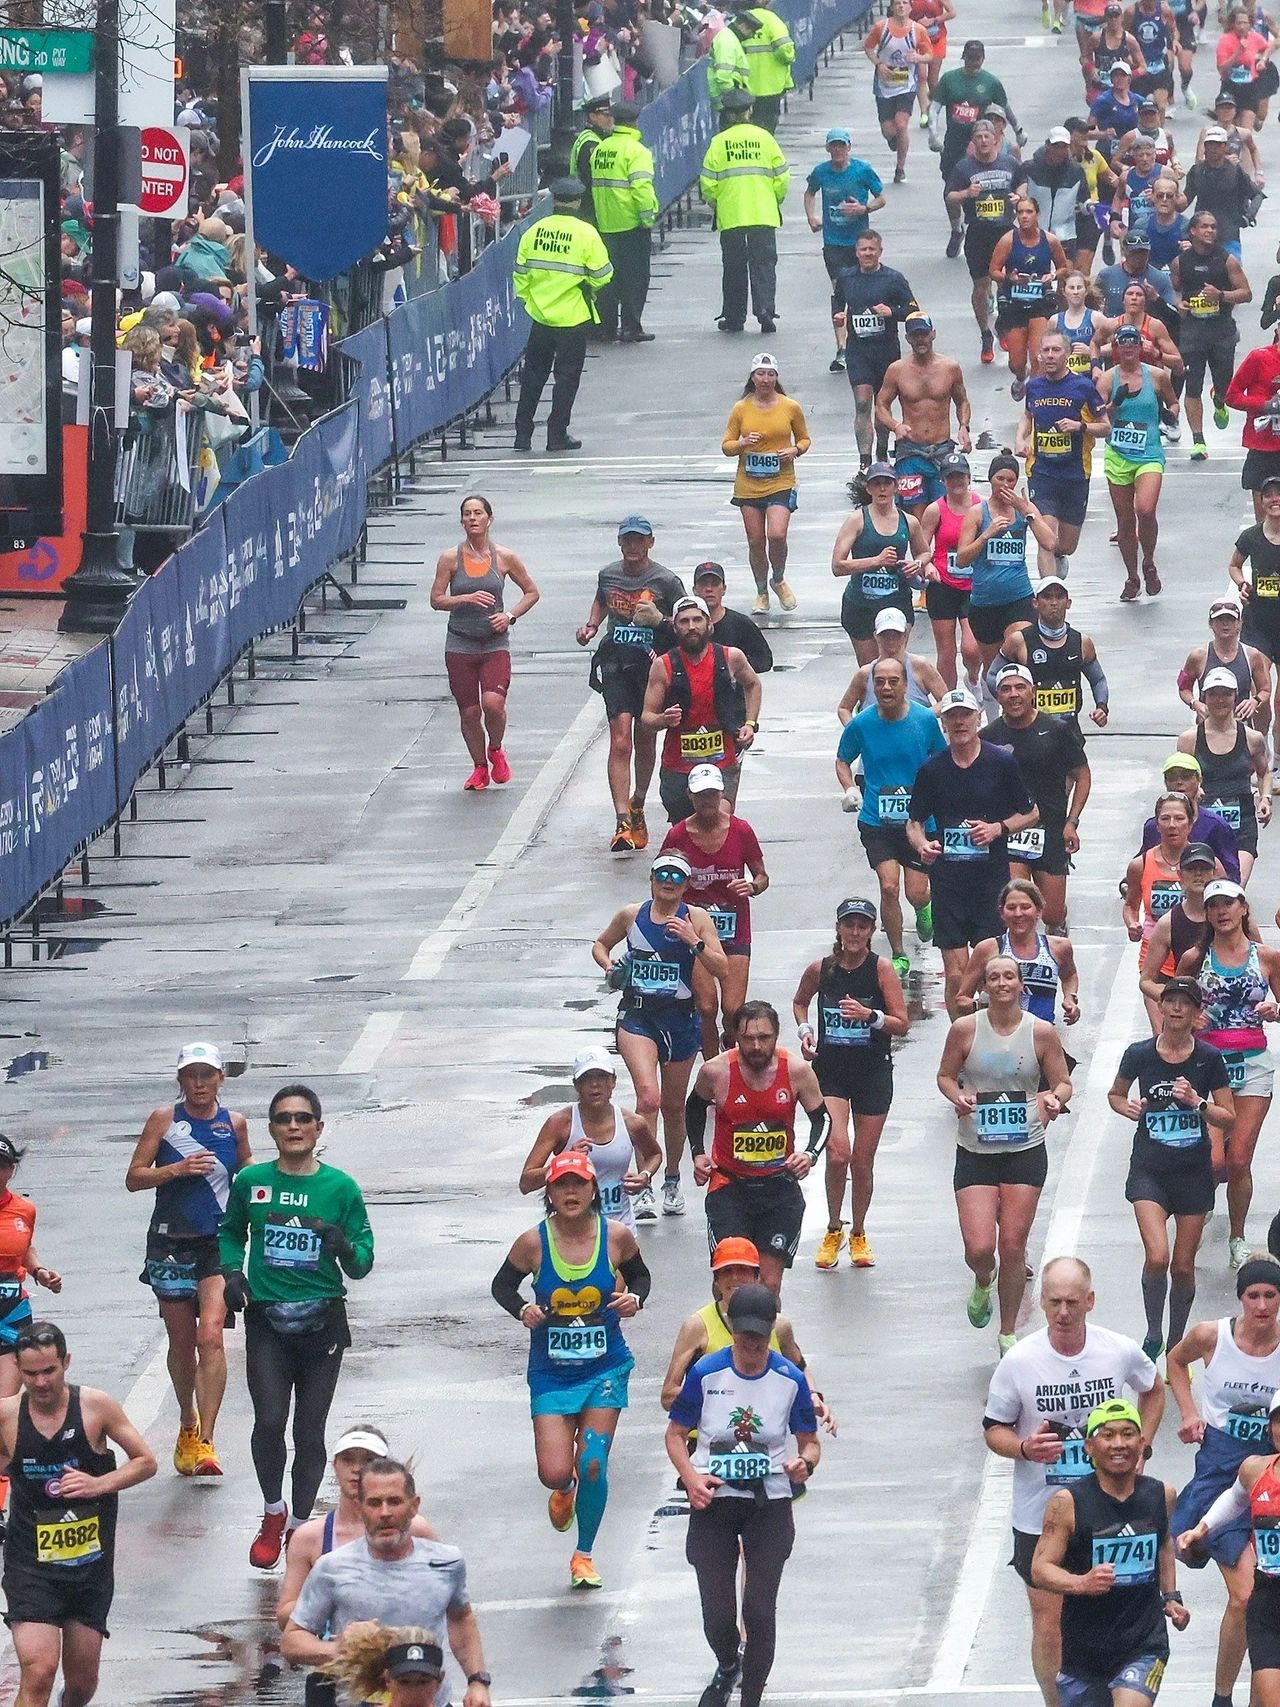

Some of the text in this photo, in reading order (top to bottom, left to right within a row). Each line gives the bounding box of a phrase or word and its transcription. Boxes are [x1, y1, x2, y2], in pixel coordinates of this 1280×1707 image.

[34, 51, 48, 66] RD
[52, 48, 66, 57] PVT
[52, 57, 66, 66] WAY
[253, 124, 384, 166] John Hancock
[725, 141, 760, 151] Boston
[141, 148, 178, 161] O NOT
[726, 150, 761, 161] Police
[142, 180, 173, 197] NTER
[535, 229, 573, 243] Boston
[533, 239, 570, 254] Police
[1034, 398, 1072, 408] SWEDEN
[1113, 431, 1146, 445] 16297
[14, 540, 25, 549] 83
[1039, 692, 1075, 709] 31501
[633, 963, 679, 980] 23055
[979, 1108, 1026, 1124] 18153
[281, 1192, 307, 1207] EIJI
[1036, 1378, 1115, 1397] ARIZONA STATE
[1224, 1382, 1248, 1390] FLEET
[1037, 1390, 1115, 1412] SUN DEVILS
[711, 1459, 769, 1477] 21983
[40, 1523, 96, 1549] 24682
[1097, 1540, 1152, 1563] 17741
